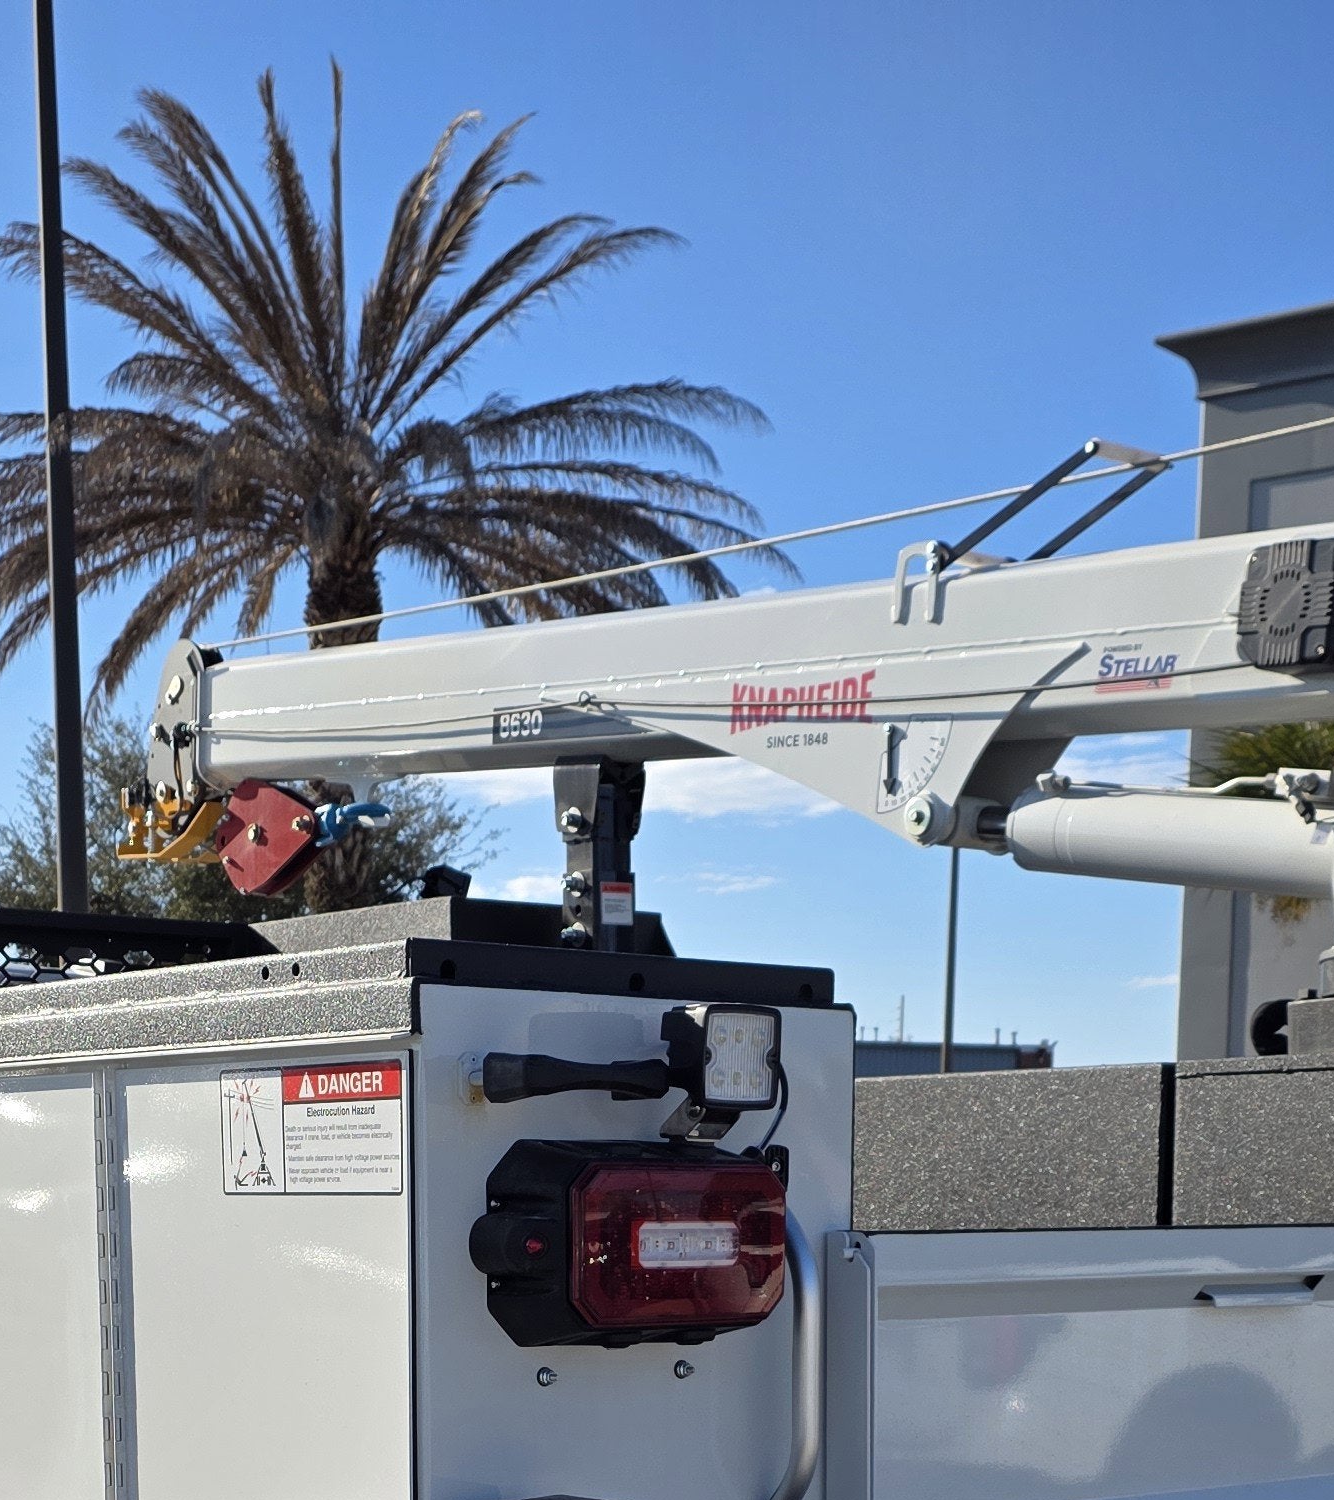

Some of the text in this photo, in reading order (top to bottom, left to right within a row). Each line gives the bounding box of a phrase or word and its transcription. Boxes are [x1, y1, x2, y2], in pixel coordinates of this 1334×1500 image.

[1098, 653, 1178, 677] STELLAR
[730, 668, 876, 735] KNAPHEIDE
[500, 709, 543, 738] 8630
[767, 732, 829, 749] SINCE 1848
[317, 1071, 383, 1095] DANGER
[306, 1104, 376, 1118] Electrocution Hazard
